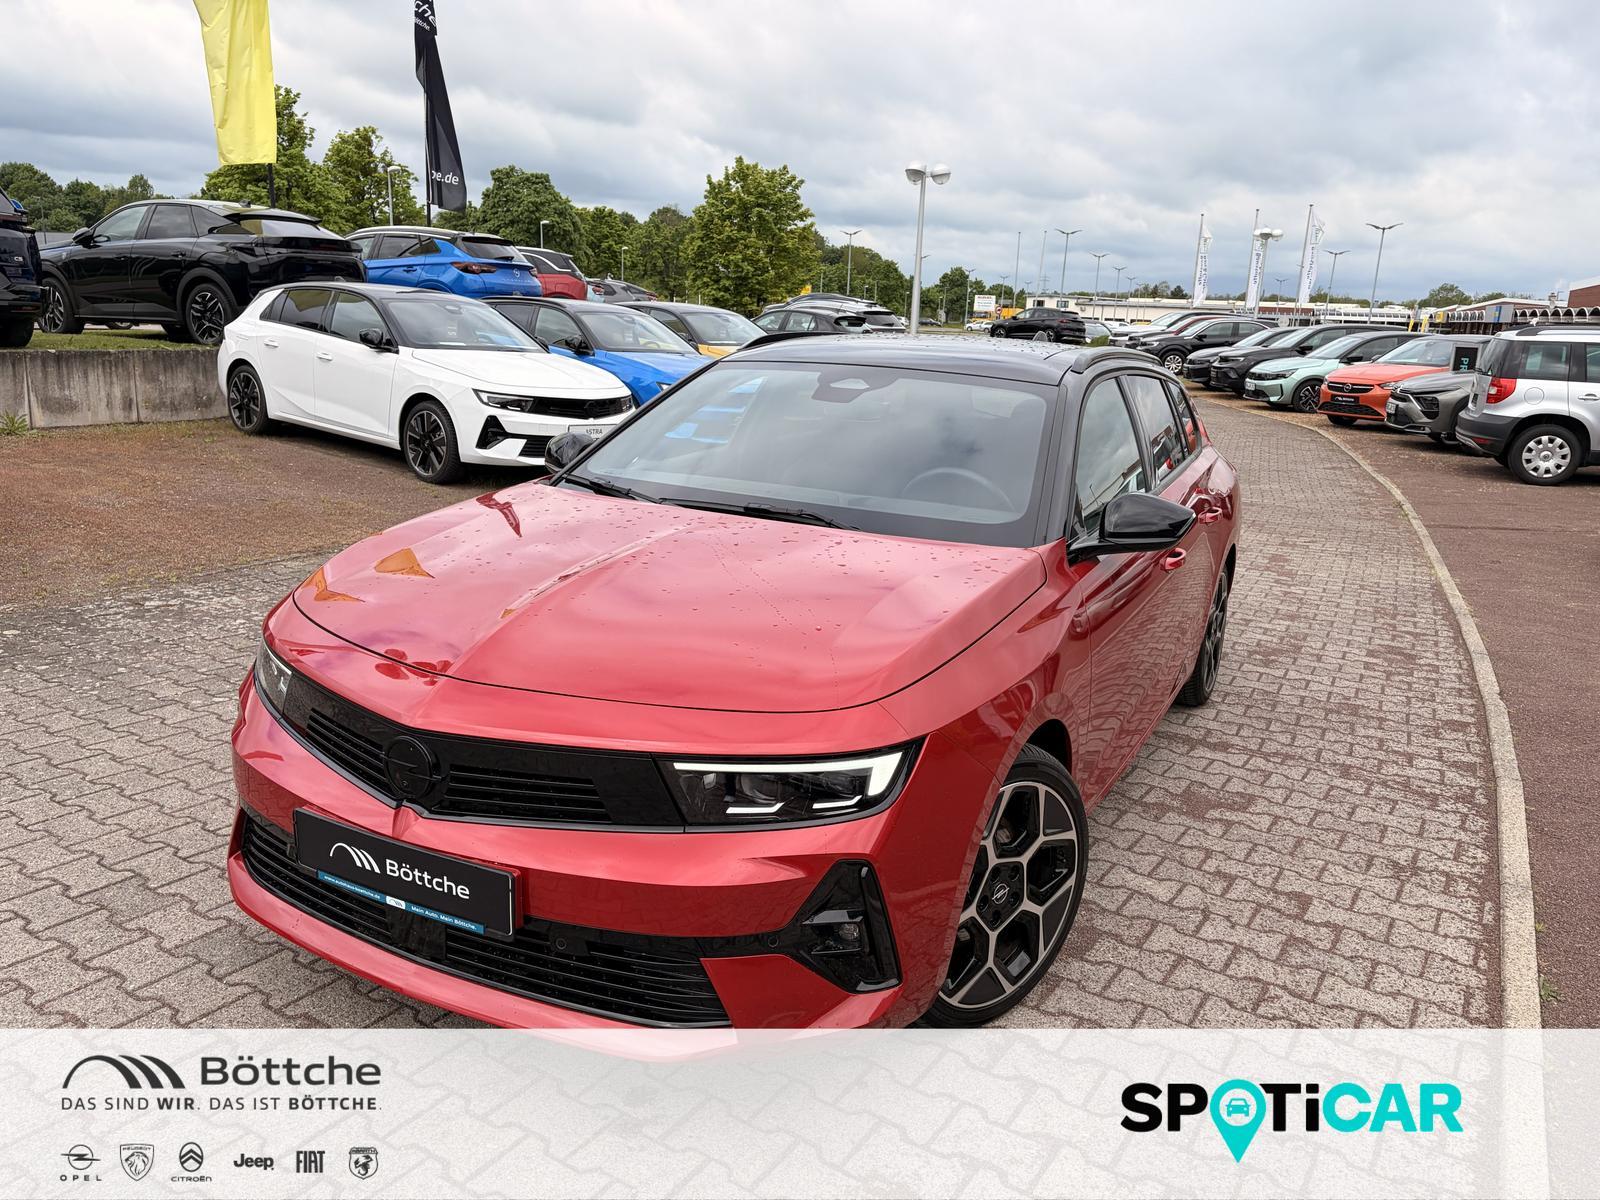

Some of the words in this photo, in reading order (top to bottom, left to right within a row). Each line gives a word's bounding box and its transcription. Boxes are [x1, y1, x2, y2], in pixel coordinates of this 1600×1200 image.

[385, 858, 470, 900] Böttche
[411, 905, 425, 914] Mein
[440, 914, 454, 923] Mein
